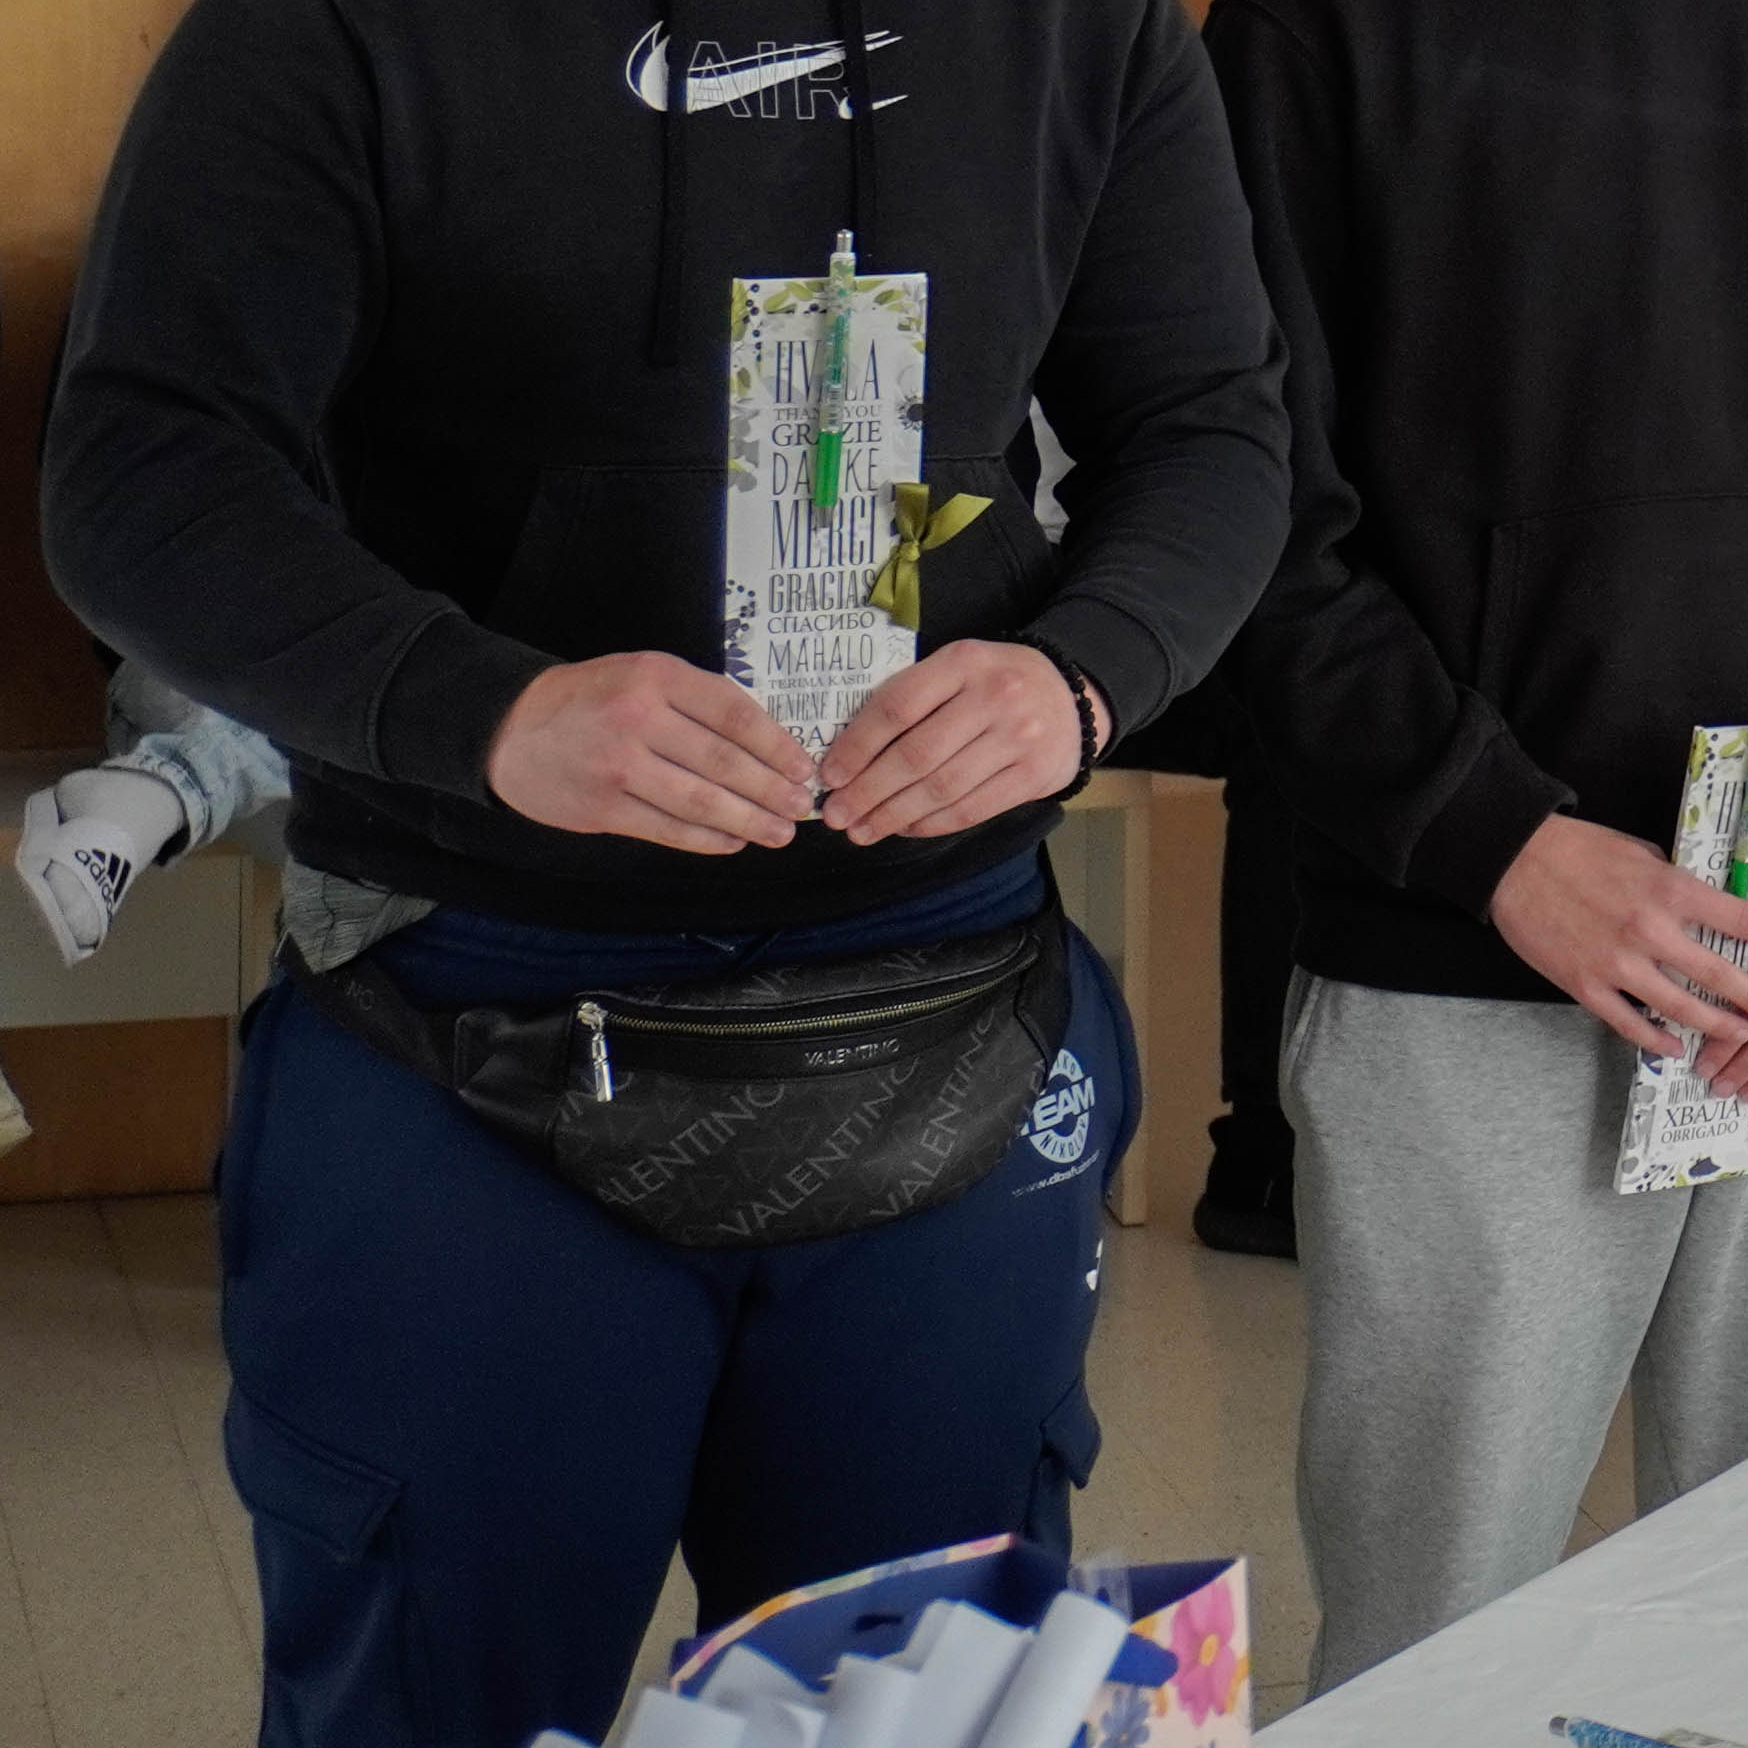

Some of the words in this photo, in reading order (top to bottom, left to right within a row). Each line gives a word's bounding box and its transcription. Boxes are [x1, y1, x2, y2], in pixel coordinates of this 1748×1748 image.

[774, 338, 881, 404] HVLA
[845, 404, 881, 419] YOU
[771, 420, 882, 447] GRZIE
[772, 448, 881, 496] DAKE
[769, 495, 878, 571] MERCI
[767, 611, 876, 635] СПАСИБО
[767, 634, 874, 676] MAHALO
[74, 849, 113, 933] adida
[1660, 1120, 1739, 1144] OBRIGADO
